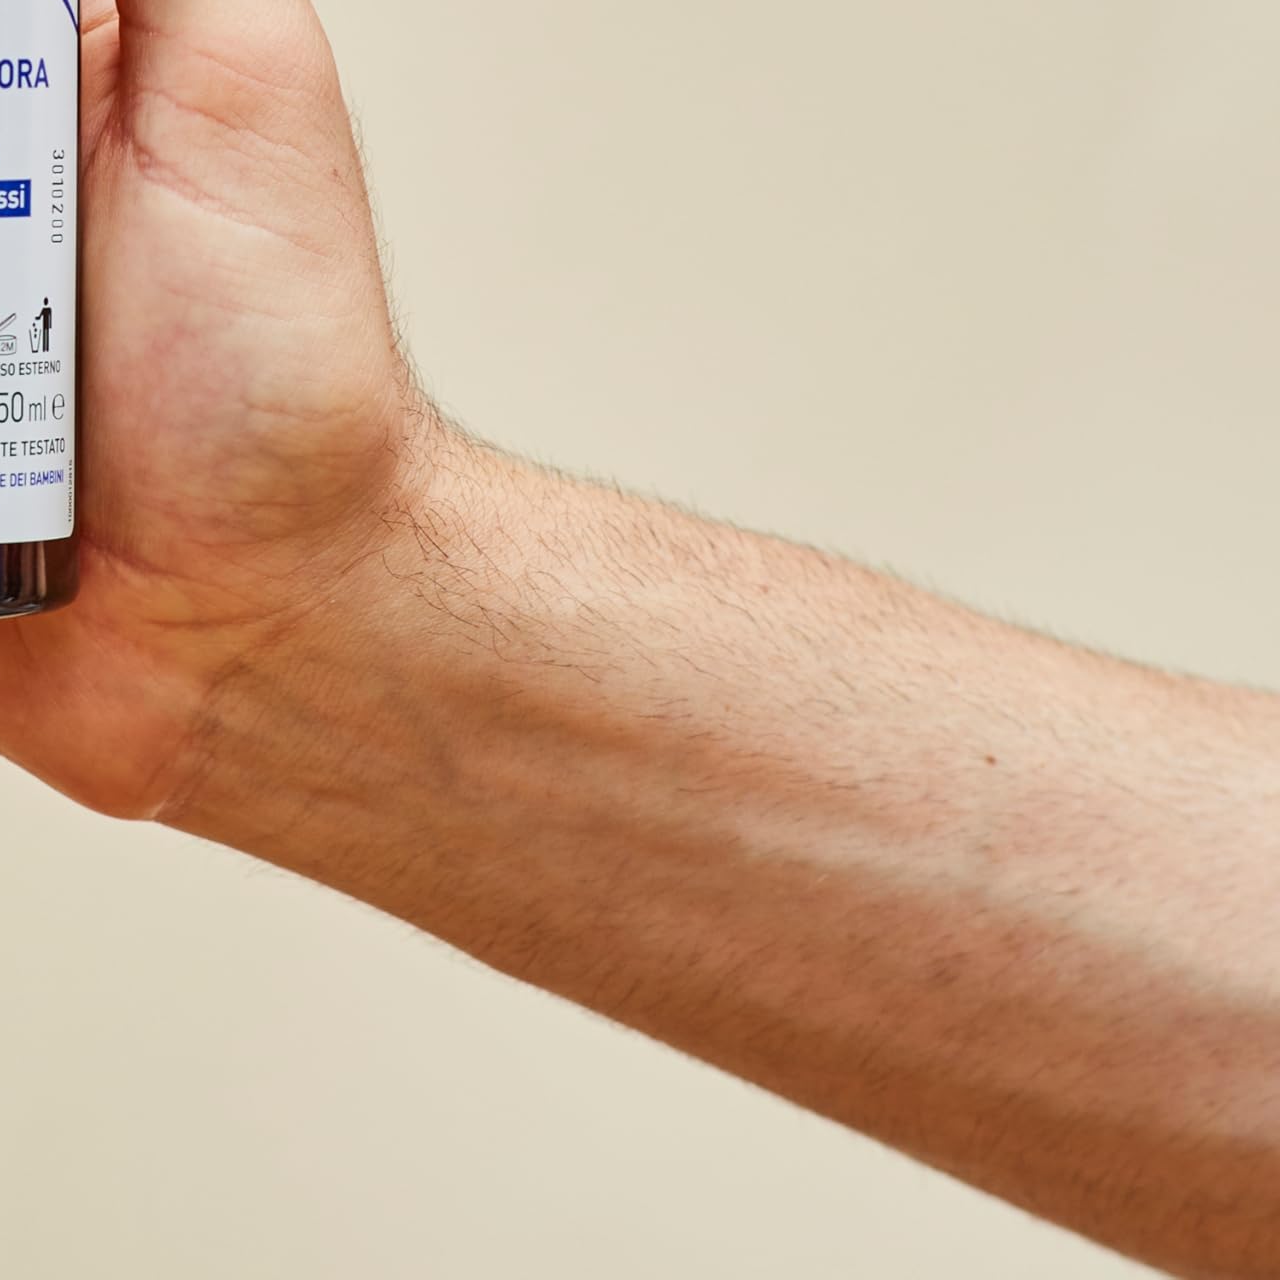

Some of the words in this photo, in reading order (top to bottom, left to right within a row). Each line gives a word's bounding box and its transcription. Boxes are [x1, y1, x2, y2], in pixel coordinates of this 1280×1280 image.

[51, 148, 65, 245] 3010200
[19, 360, 61, 376] ESTERNO
[28, 395, 46, 421] ml
[21, 437, 66, 455] TESTATO
[10, 472, 27, 487] DEI
[30, 468, 65, 486] BAMBINI
